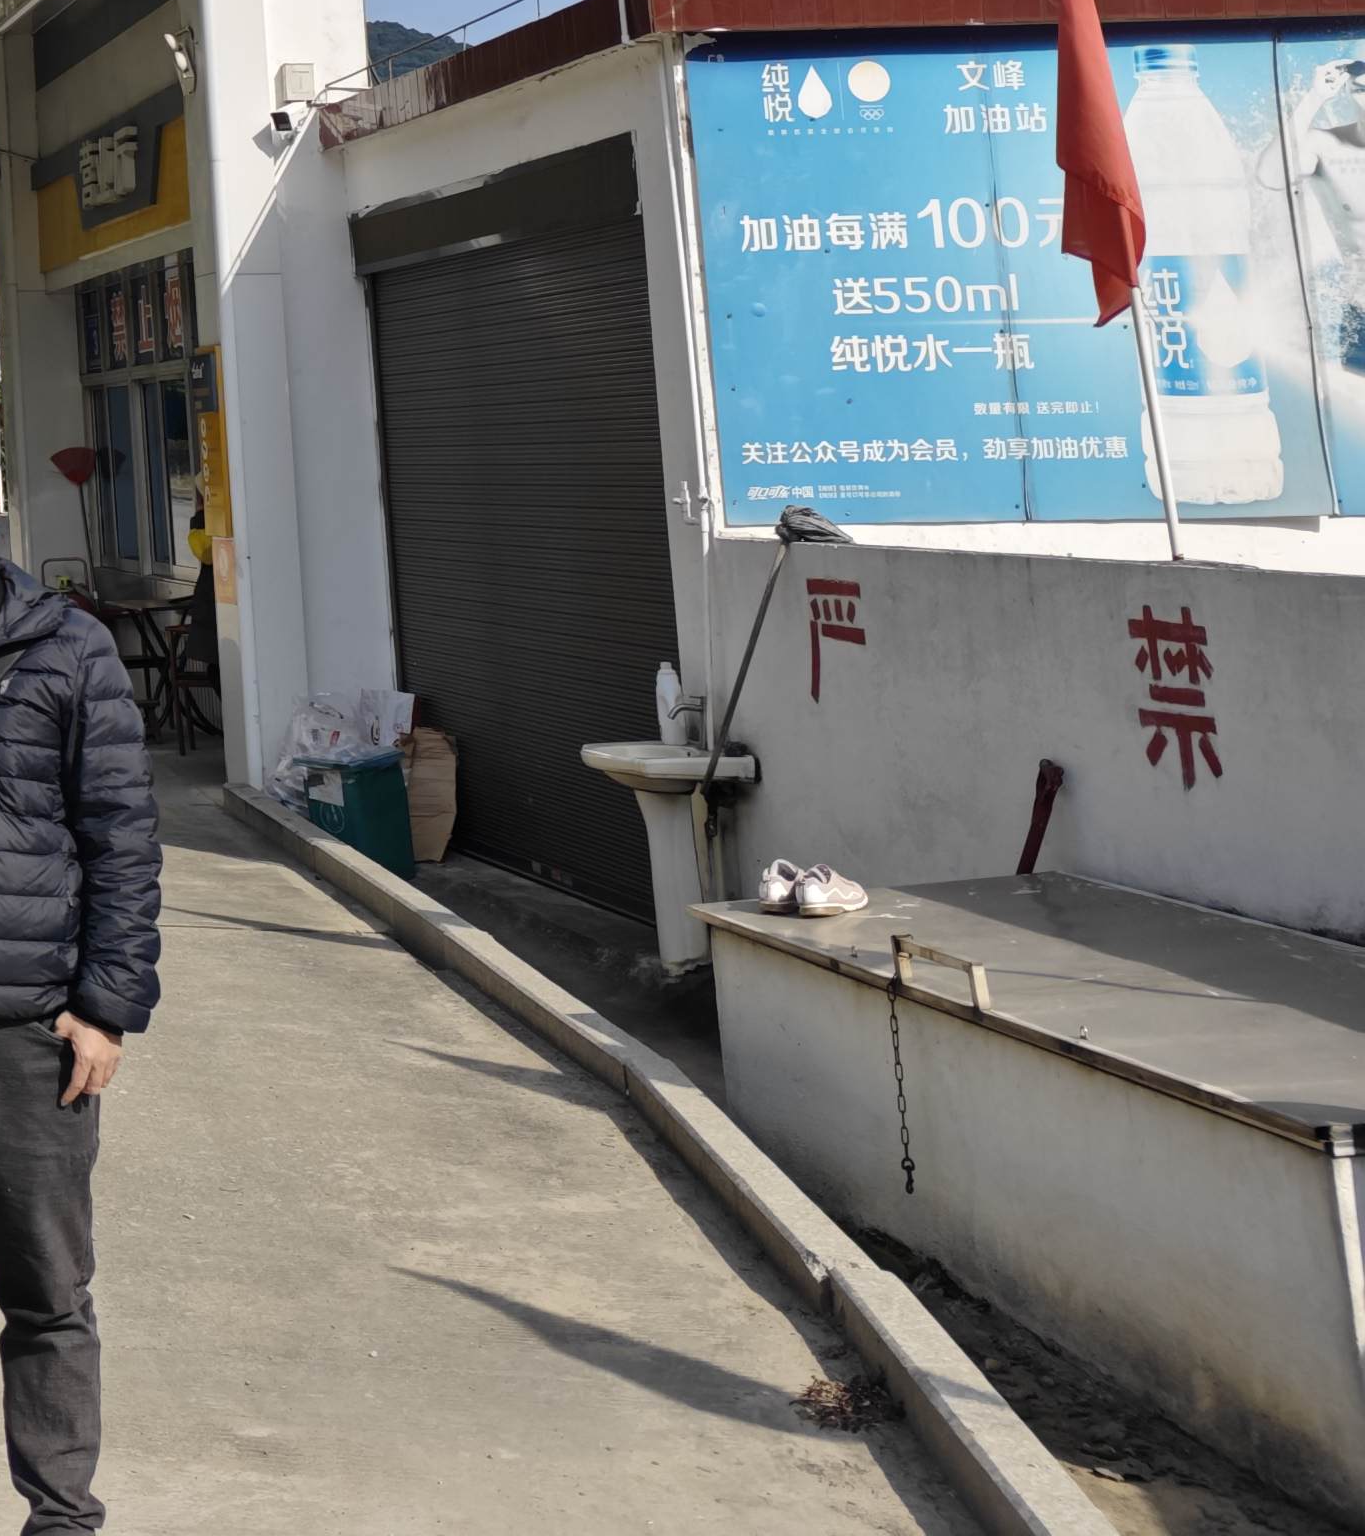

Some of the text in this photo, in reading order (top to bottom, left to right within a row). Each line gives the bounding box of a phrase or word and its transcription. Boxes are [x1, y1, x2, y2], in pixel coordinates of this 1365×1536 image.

[761, 63, 796, 123] 纯悦
[956, 60, 1026, 92] 文峰
[942, 103, 1047, 135] 加油站
[832, 274, 1019, 316] 送550ml
[830, 333, 1034, 373] 纯悦水一瓶
[973, 401, 1030, 416] 数量有限
[806, 577, 1223, 791] 严 禁
